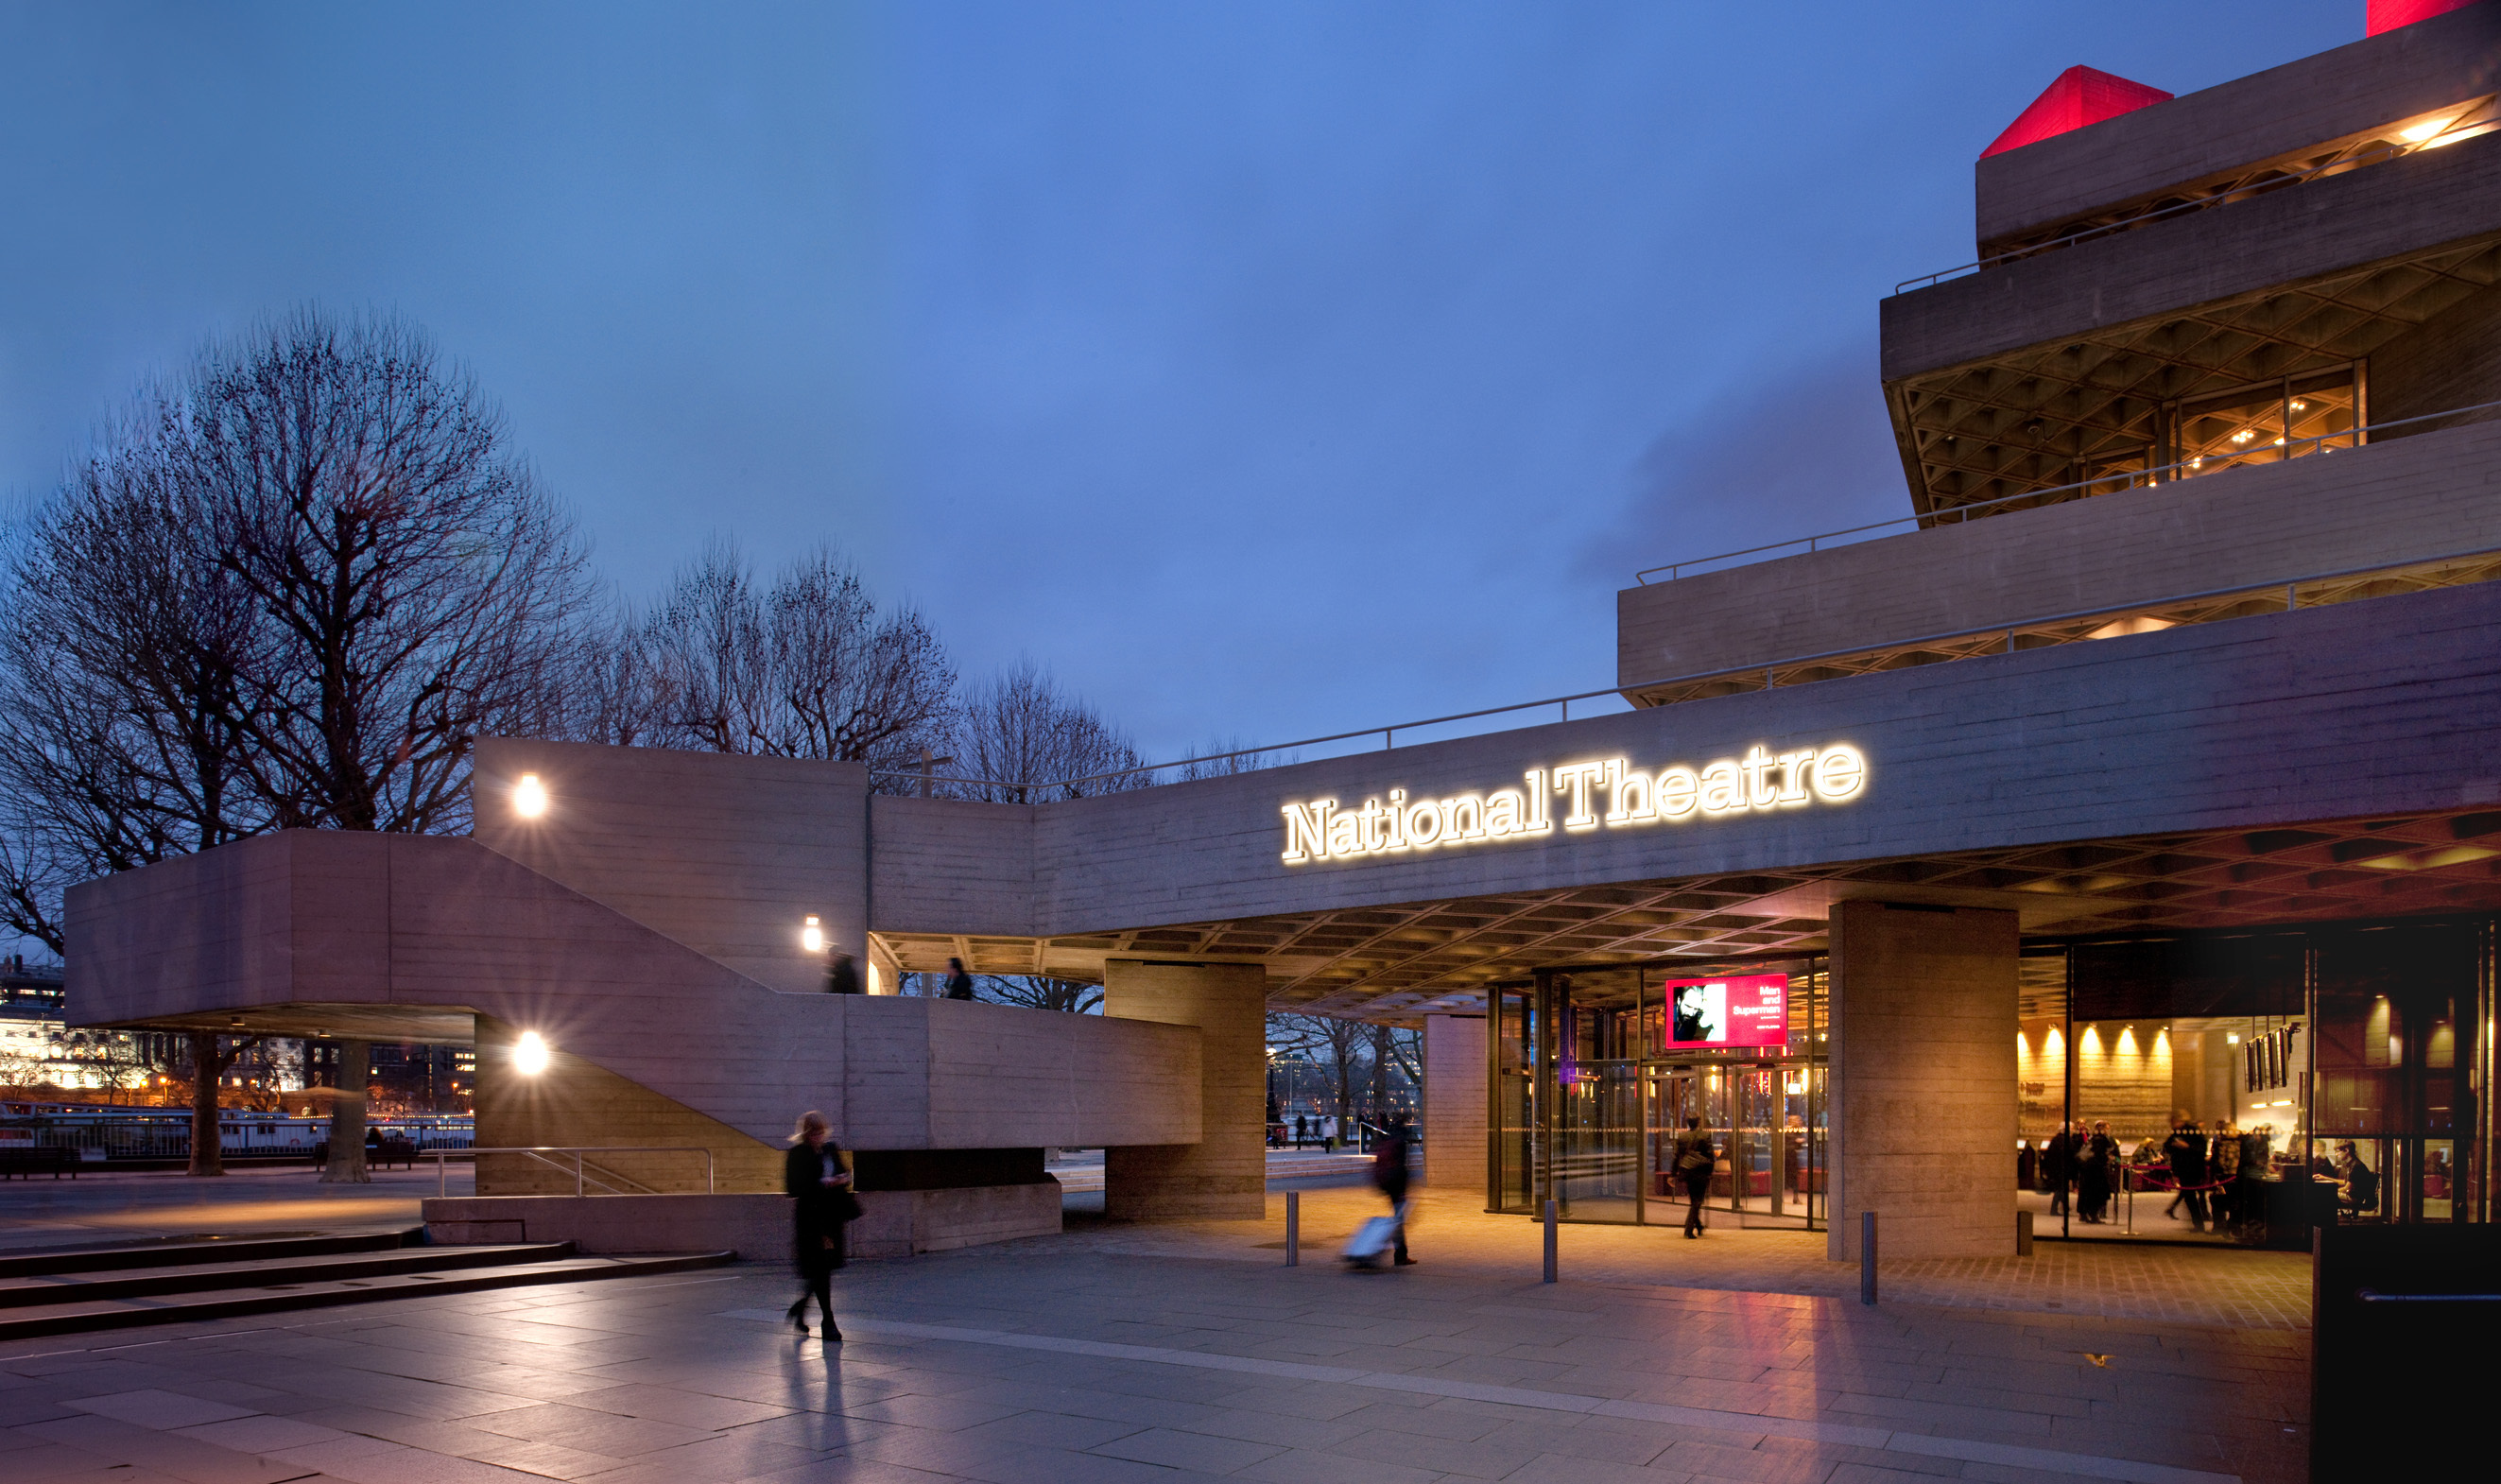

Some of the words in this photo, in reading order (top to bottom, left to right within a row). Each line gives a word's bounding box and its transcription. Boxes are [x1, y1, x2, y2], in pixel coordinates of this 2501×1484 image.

[1281, 768, 1550, 862] National
[1553, 744, 1863, 828] Theatre
[1759, 986, 1781, 995] Man
[1762, 995, 1781, 1005] and
[1733, 1005, 1781, 1016] Superman
